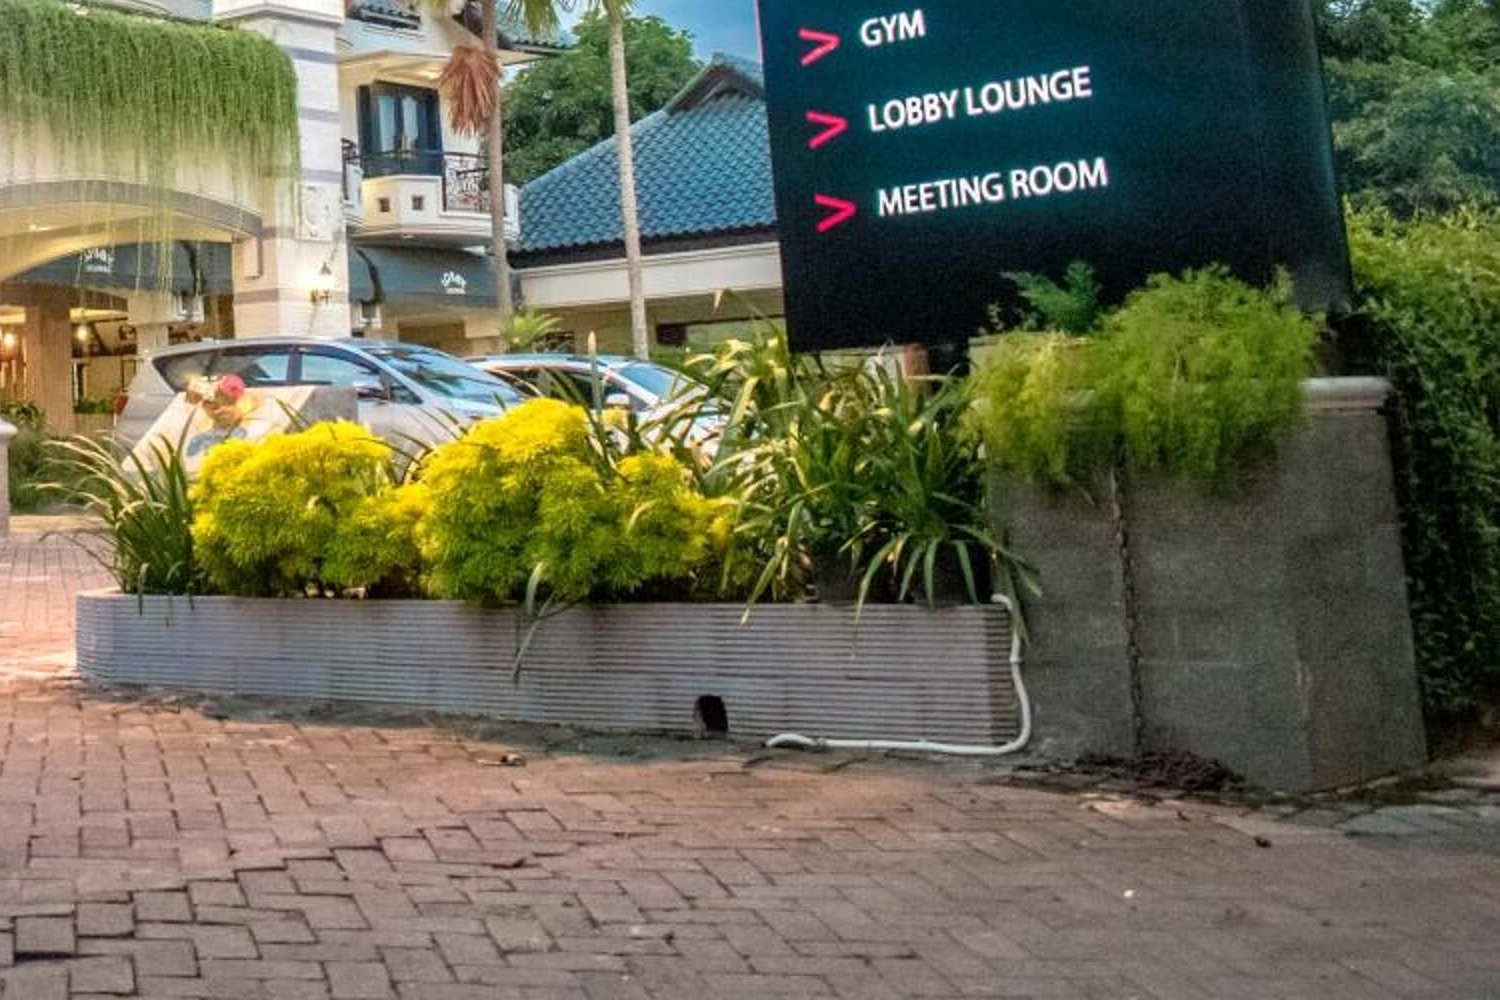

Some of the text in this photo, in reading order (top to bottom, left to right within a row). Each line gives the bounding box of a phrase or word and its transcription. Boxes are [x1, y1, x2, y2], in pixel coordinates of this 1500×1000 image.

[859, 9, 926, 48] GYM
[868, 66, 1093, 133] LOBBY LOUNGE
[877, 156, 1109, 217] MEETING ROOM
